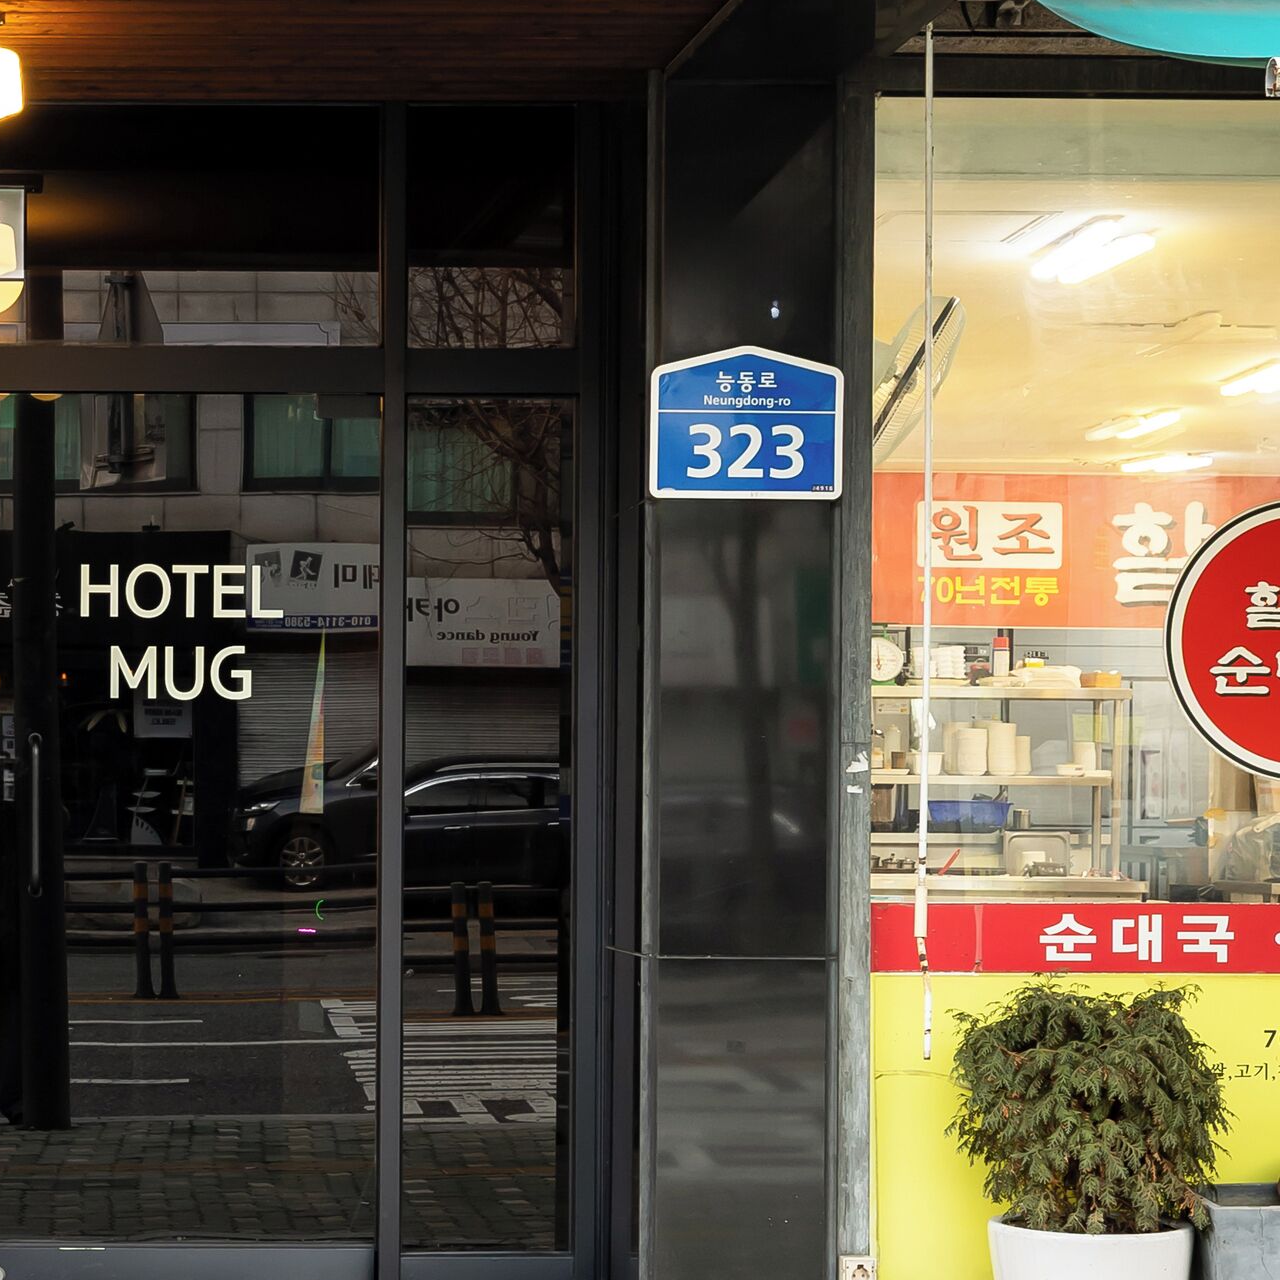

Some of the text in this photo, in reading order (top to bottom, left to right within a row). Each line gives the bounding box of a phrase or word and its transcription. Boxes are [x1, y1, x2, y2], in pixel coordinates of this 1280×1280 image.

[703, 394, 791, 408] Neungdong-ro
[715, 371, 778, 393] 능동로
[686, 423, 805, 479] 323
[931, 505, 1055, 561] 원조
[79, 563, 284, 619] HOTEL
[109, 645, 253, 701] MUG
[1209, 646, 1280, 698] 순
[1039, 913, 1235, 963] 순대국
